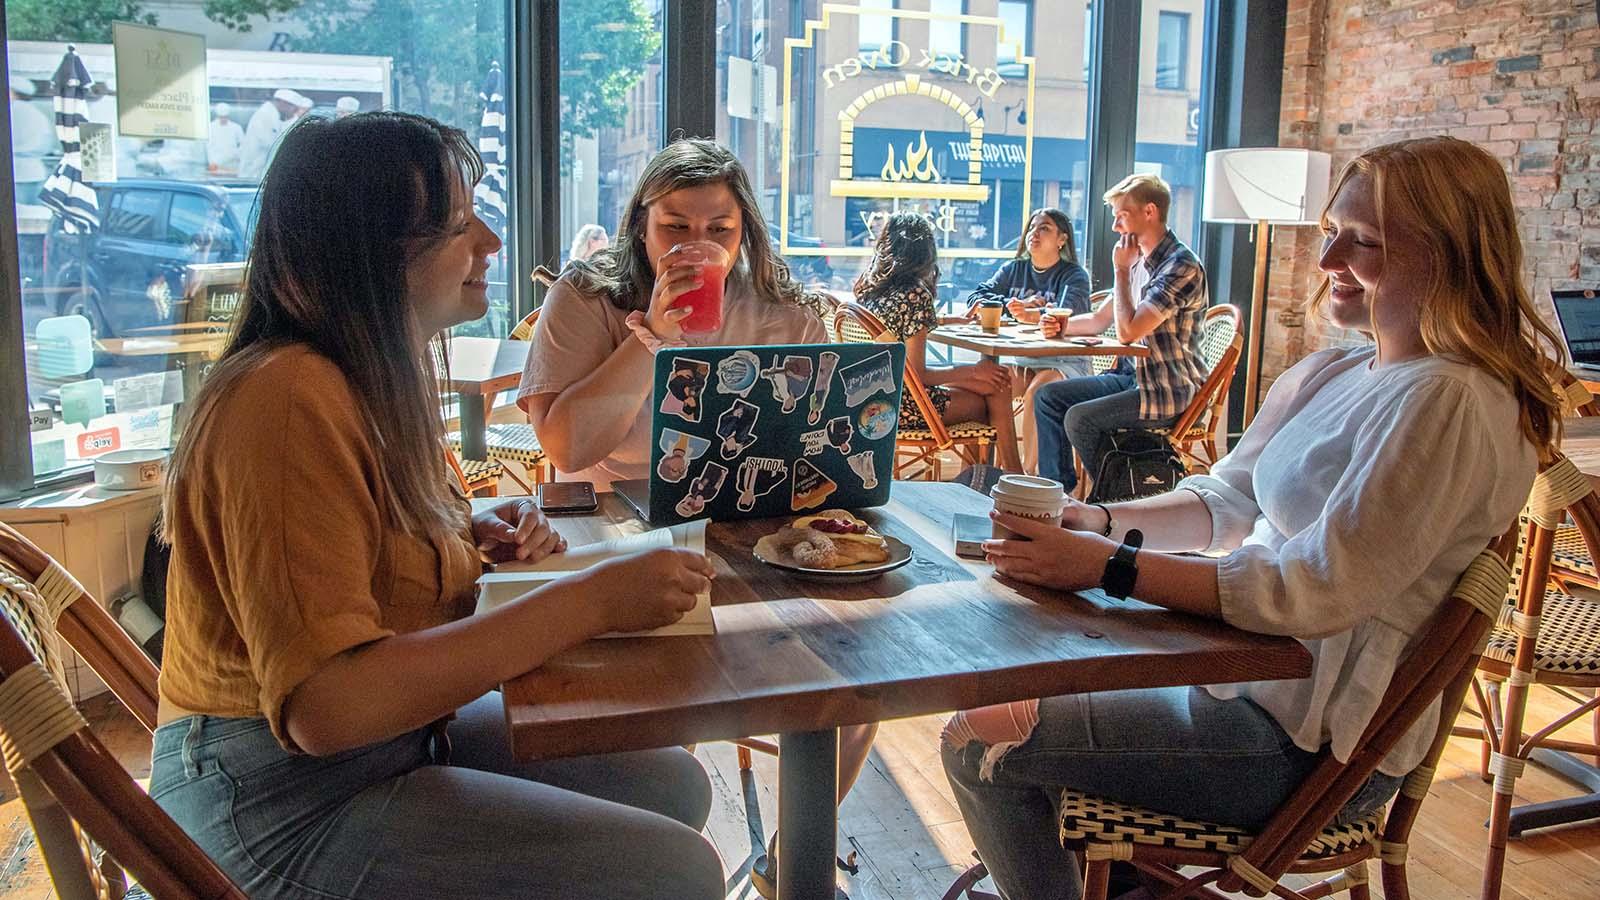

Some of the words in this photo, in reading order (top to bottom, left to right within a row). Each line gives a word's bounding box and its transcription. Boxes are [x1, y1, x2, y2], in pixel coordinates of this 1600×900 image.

[980, 143, 1026, 163] APITAL
[33, 415, 49, 425] Pay
[746, 457, 783, 471] YOUTHS!
